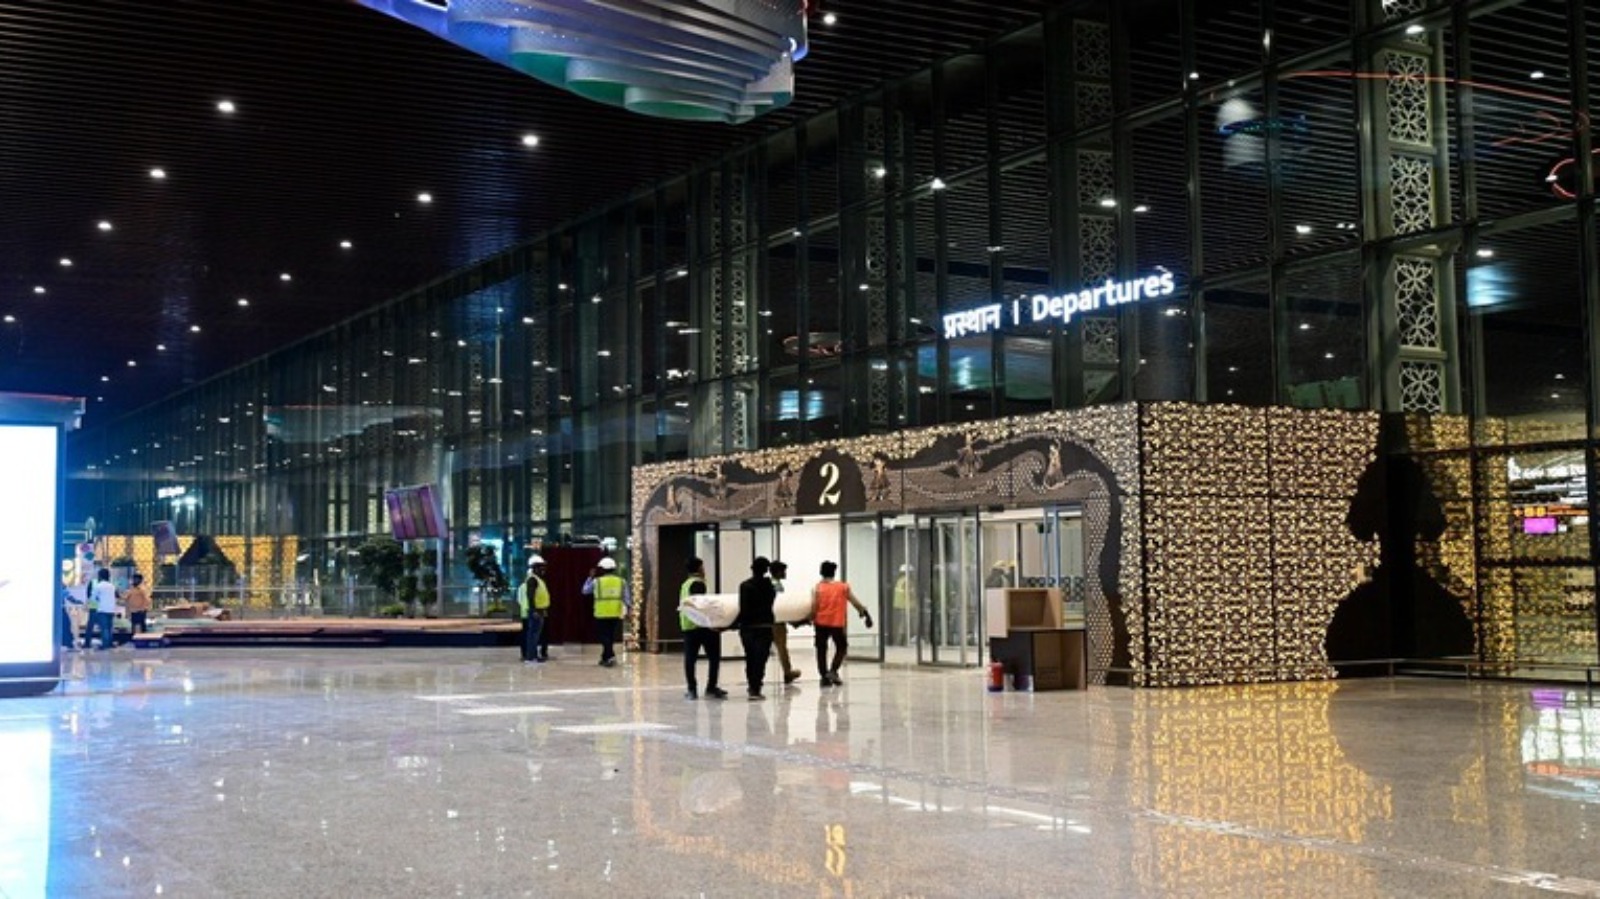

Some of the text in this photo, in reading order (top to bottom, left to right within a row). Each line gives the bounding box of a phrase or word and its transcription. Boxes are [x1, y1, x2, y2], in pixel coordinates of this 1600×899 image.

[943, 303, 1002, 339] प्रस्थान
[1032, 271, 1175, 323] Departures
[818, 462, 841, 506] 2
